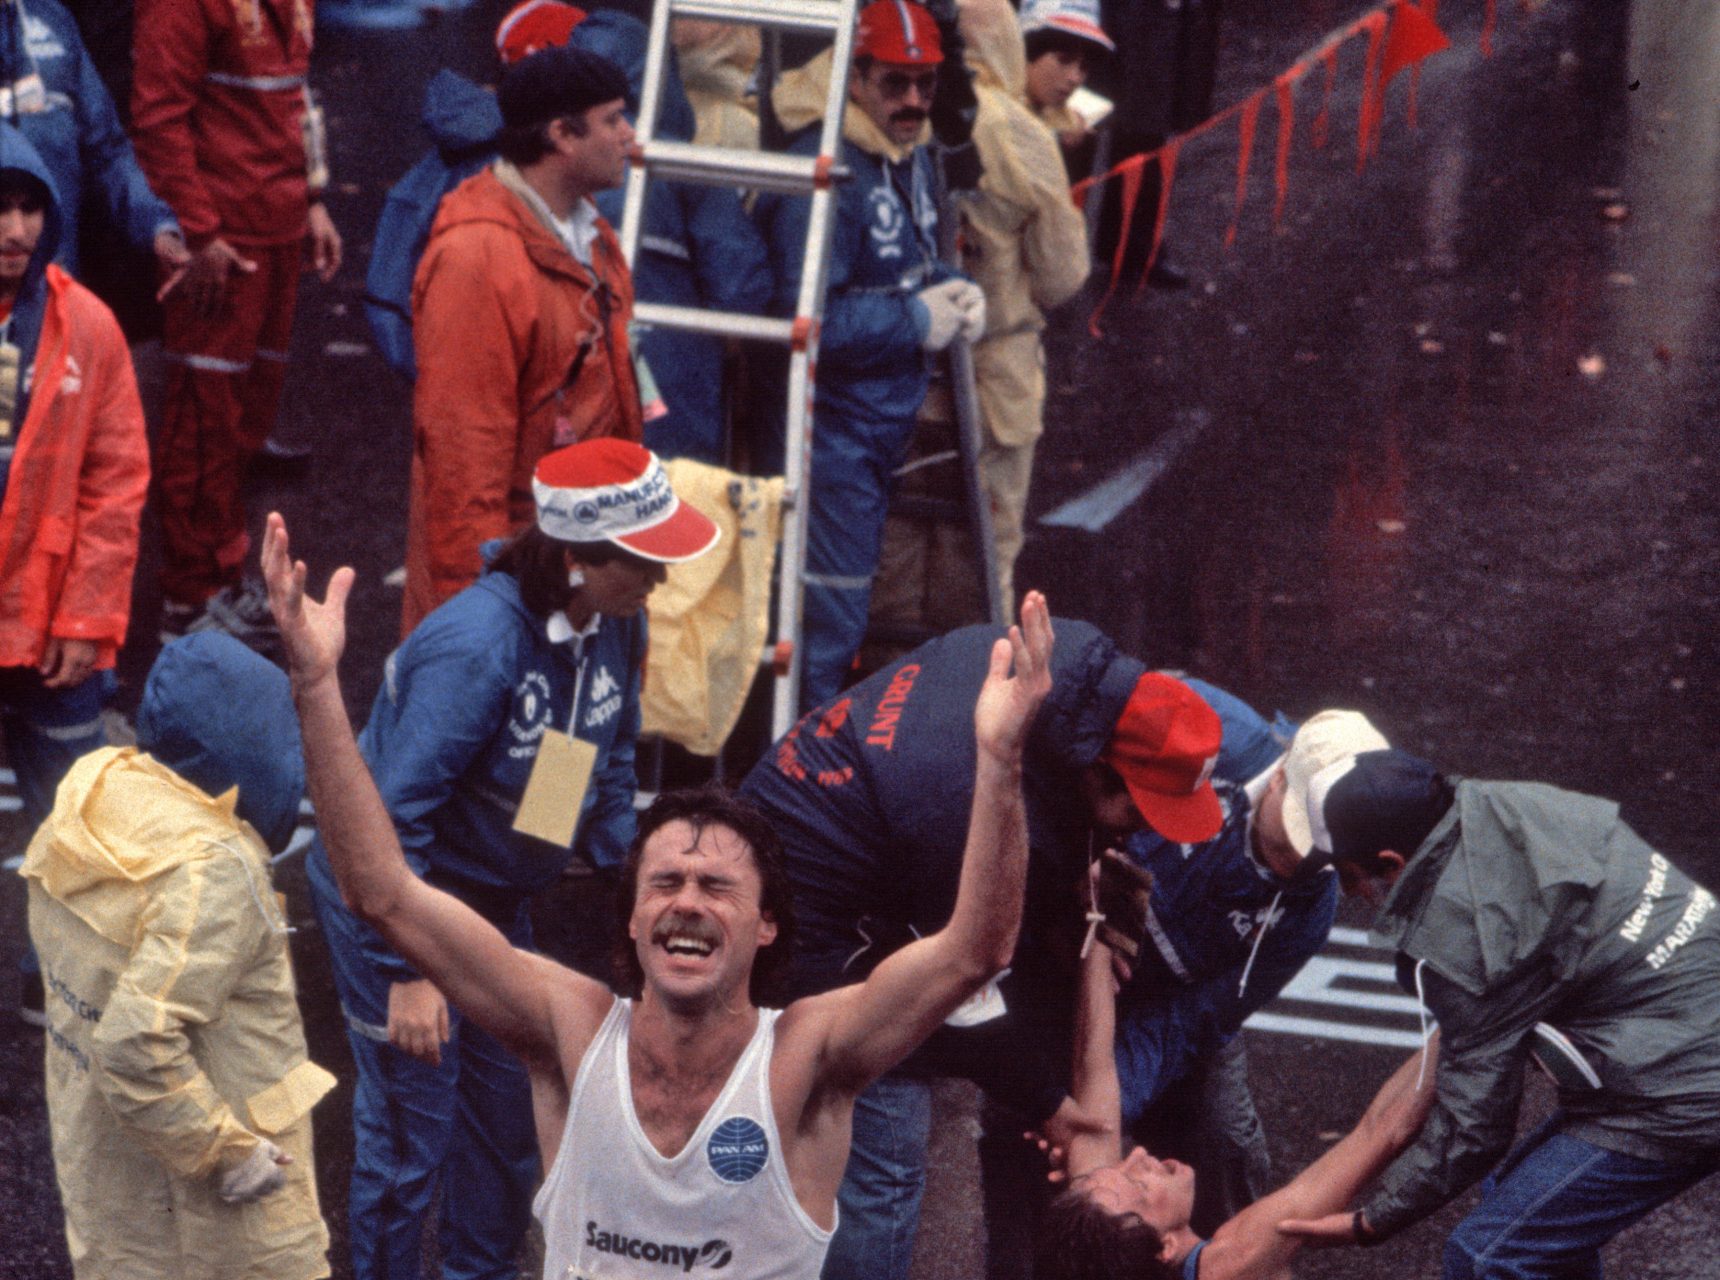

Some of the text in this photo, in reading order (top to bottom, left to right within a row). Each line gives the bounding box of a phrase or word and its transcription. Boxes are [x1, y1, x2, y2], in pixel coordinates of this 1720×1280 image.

[1619, 896, 1654, 943] New
[711, 1144, 765, 1155] PAN AM
[586, 1221, 699, 1273] Saucony
